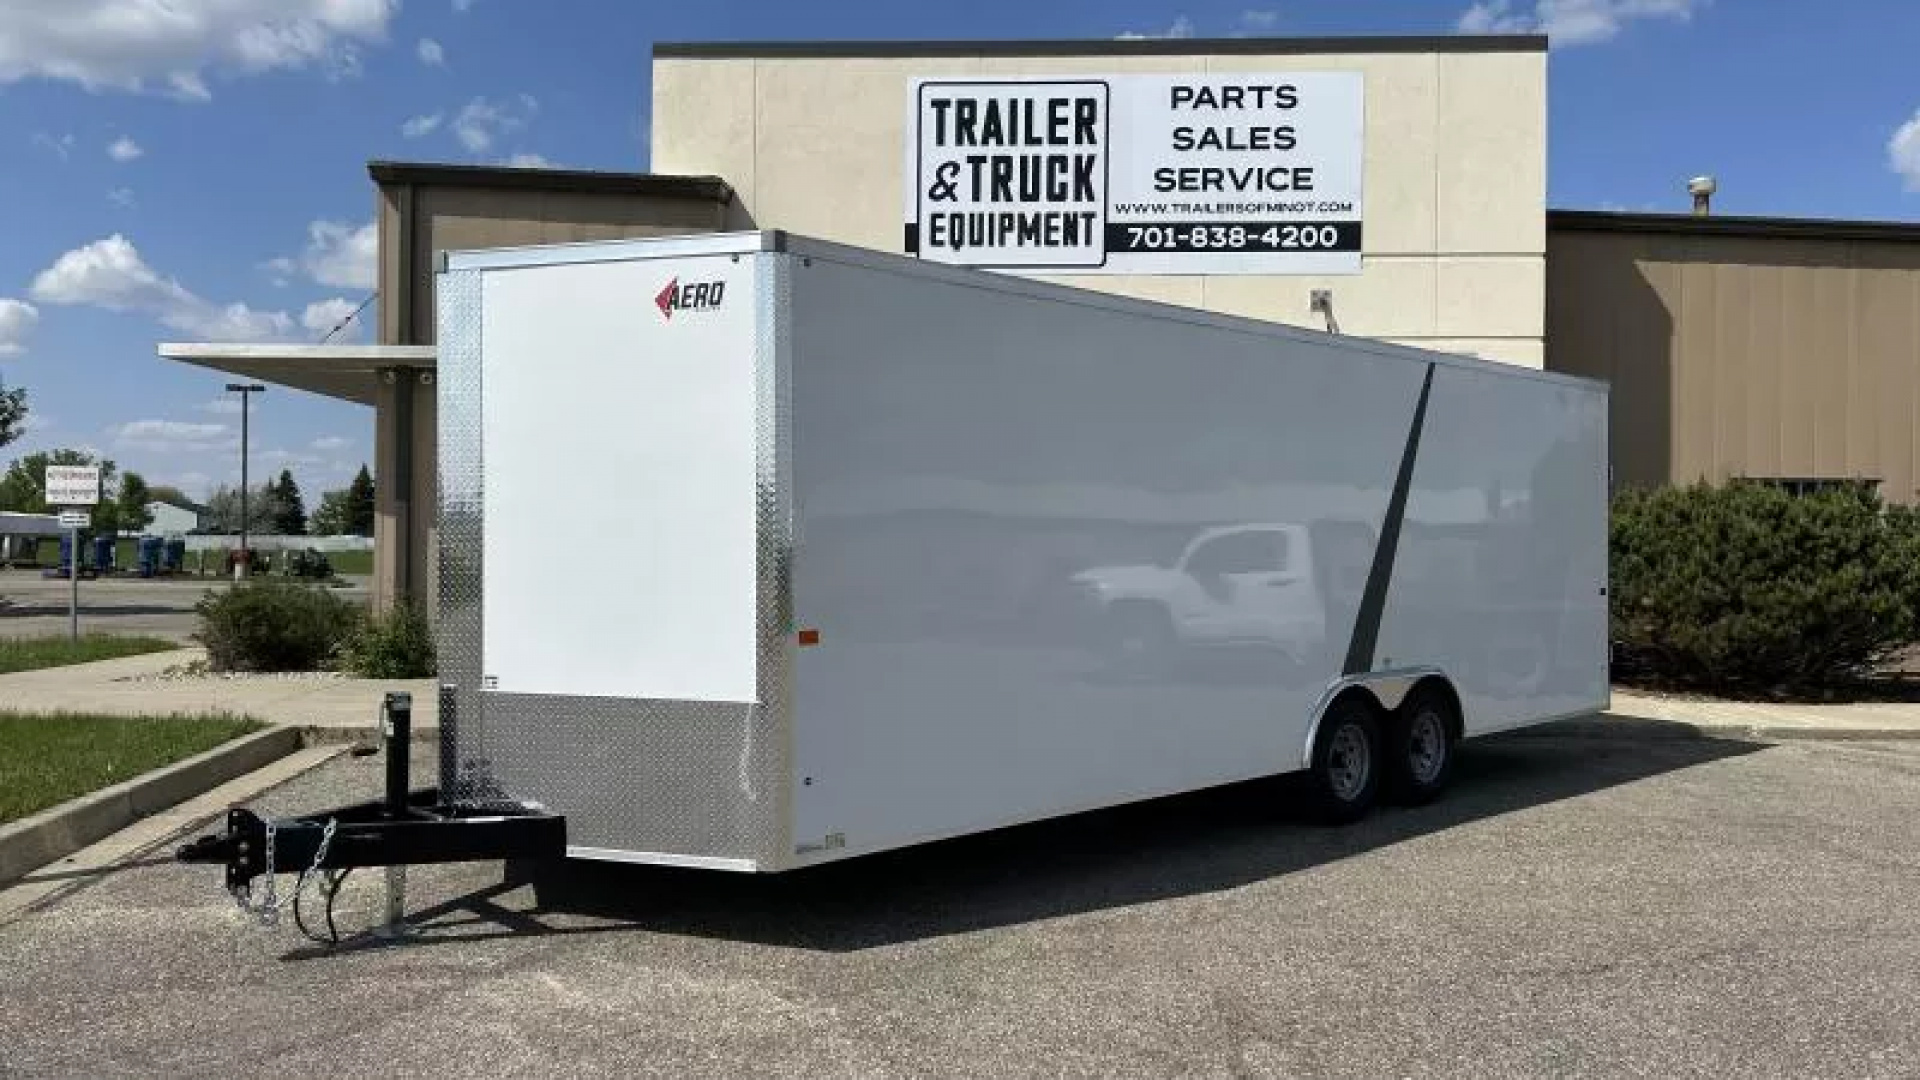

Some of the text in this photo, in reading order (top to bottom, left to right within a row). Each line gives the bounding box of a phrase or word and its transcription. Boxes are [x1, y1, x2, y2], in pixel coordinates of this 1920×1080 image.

[1171, 85, 1298, 110] PARTS
[931, 98, 1097, 147] TRAILER
[1173, 126, 1297, 152] SALES
[929, 154, 1096, 203] & TRUCK
[1154, 167, 1314, 193] SERVICE
[1115, 201, 1353, 215] WWW.TRAILERSOFMINOT.COM
[929, 211, 1096, 251] EQUIPMENT
[1127, 226, 1338, 248] 701-838-4200
[665, 281, 725, 309] AERO
